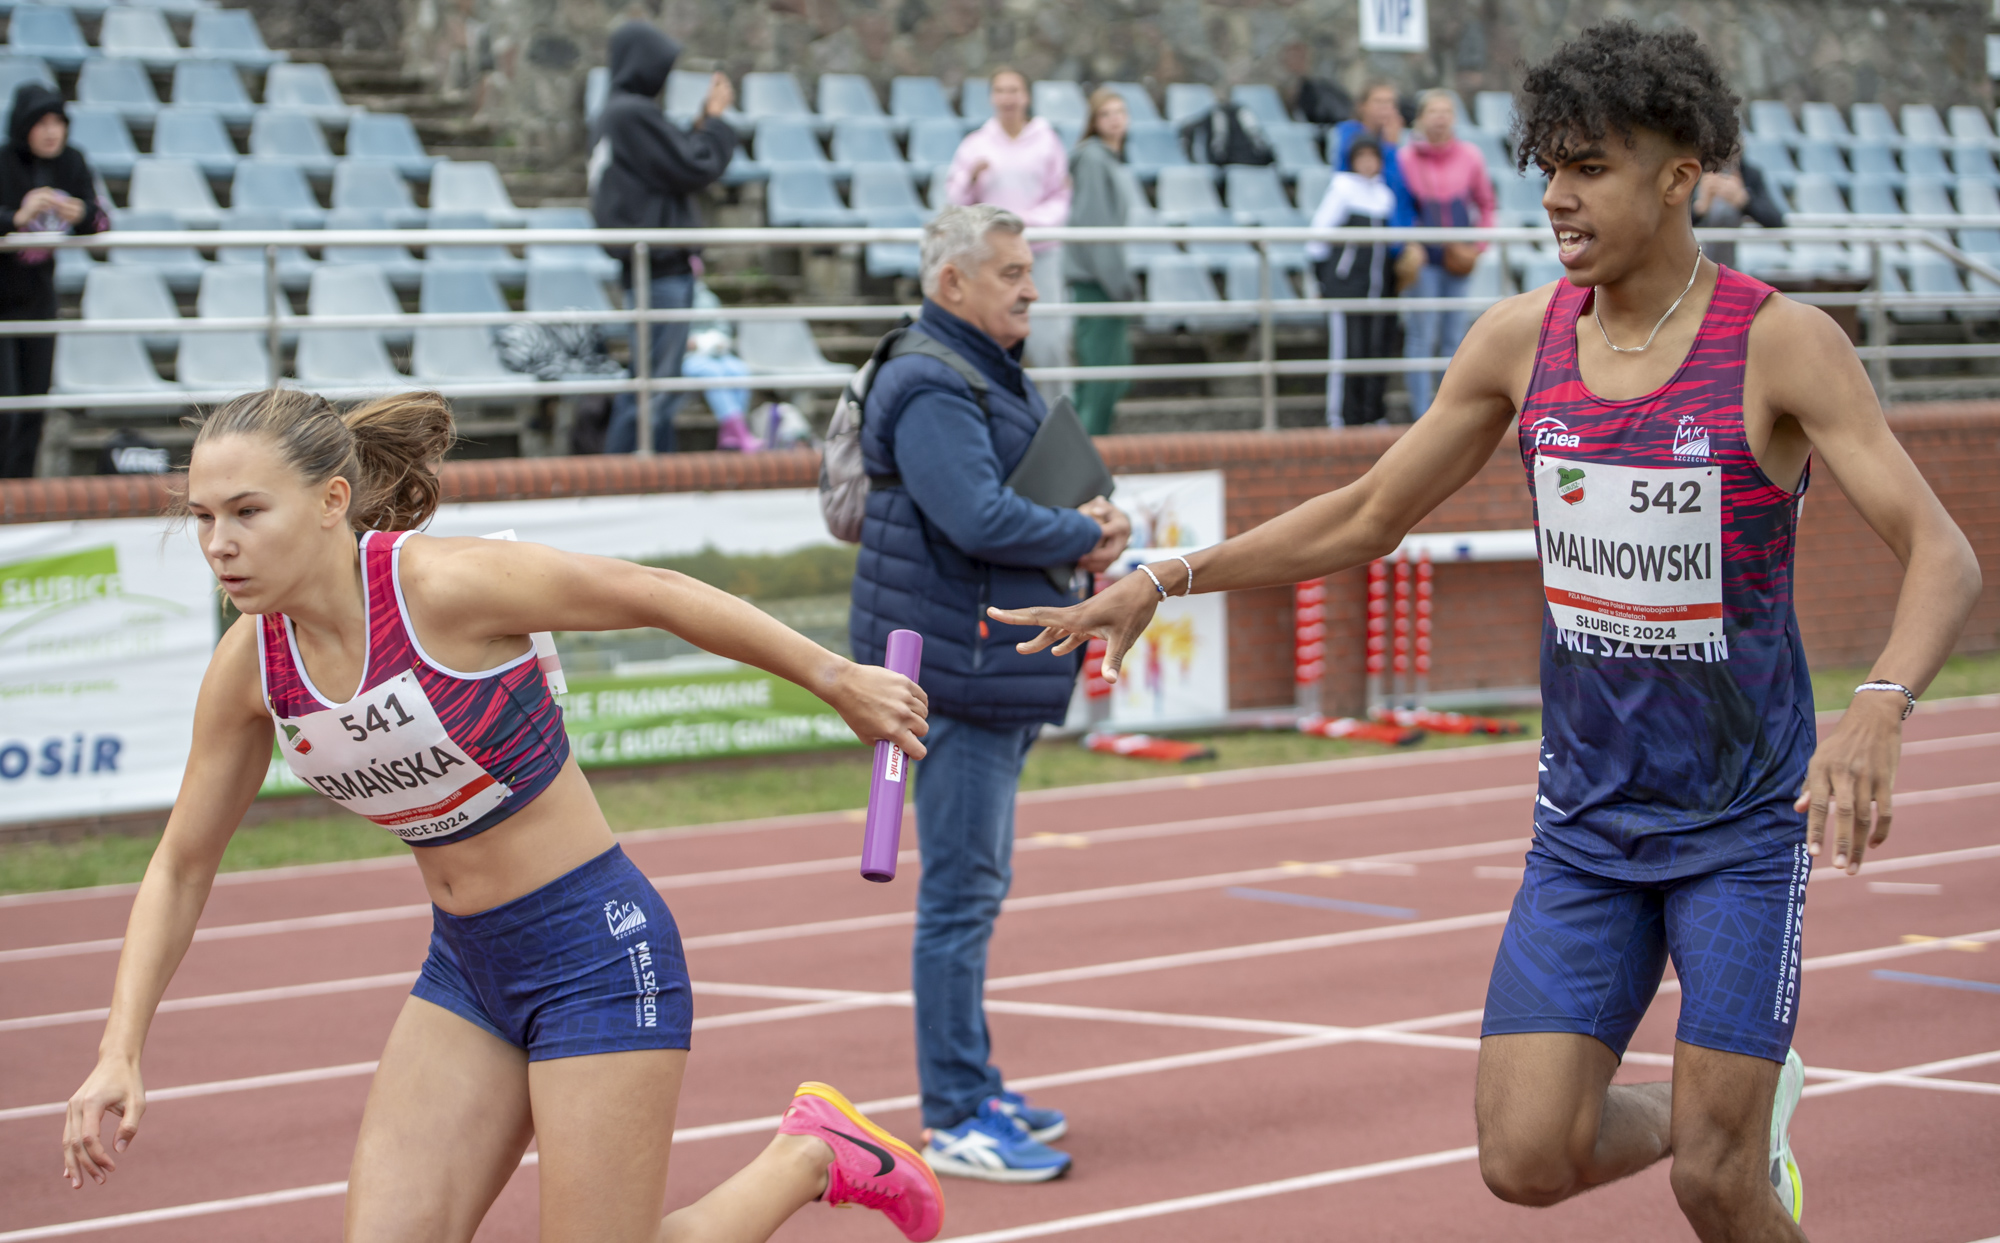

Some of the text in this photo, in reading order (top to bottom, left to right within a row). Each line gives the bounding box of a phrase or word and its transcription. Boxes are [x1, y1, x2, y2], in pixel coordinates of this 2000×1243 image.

[1535, 428, 1581, 448] Enea
[1673, 455, 1707, 463] SZCZECIN
[1629, 480, 1702, 515] 542
[1545, 528, 1712, 583] MALINOWSKI
[1609, 601, 1626, 611] Polski
[1632, 605, 1675, 615] Wielobojach
[1576, 614, 1677, 640] SŁUBICE 2024
[597, 678, 773, 718] FINANSOWANE
[339, 693, 415, 742] 541
[889, 744, 902, 777] olanik
[391, 811, 469, 838] UBICE 2024
[1788, 875, 1798, 897] KLUB
[615, 923, 647, 940] SZCZECIN
[1781, 842, 1810, 1025] MKL SZCZECIN
[635, 940, 652, 971] MKL
